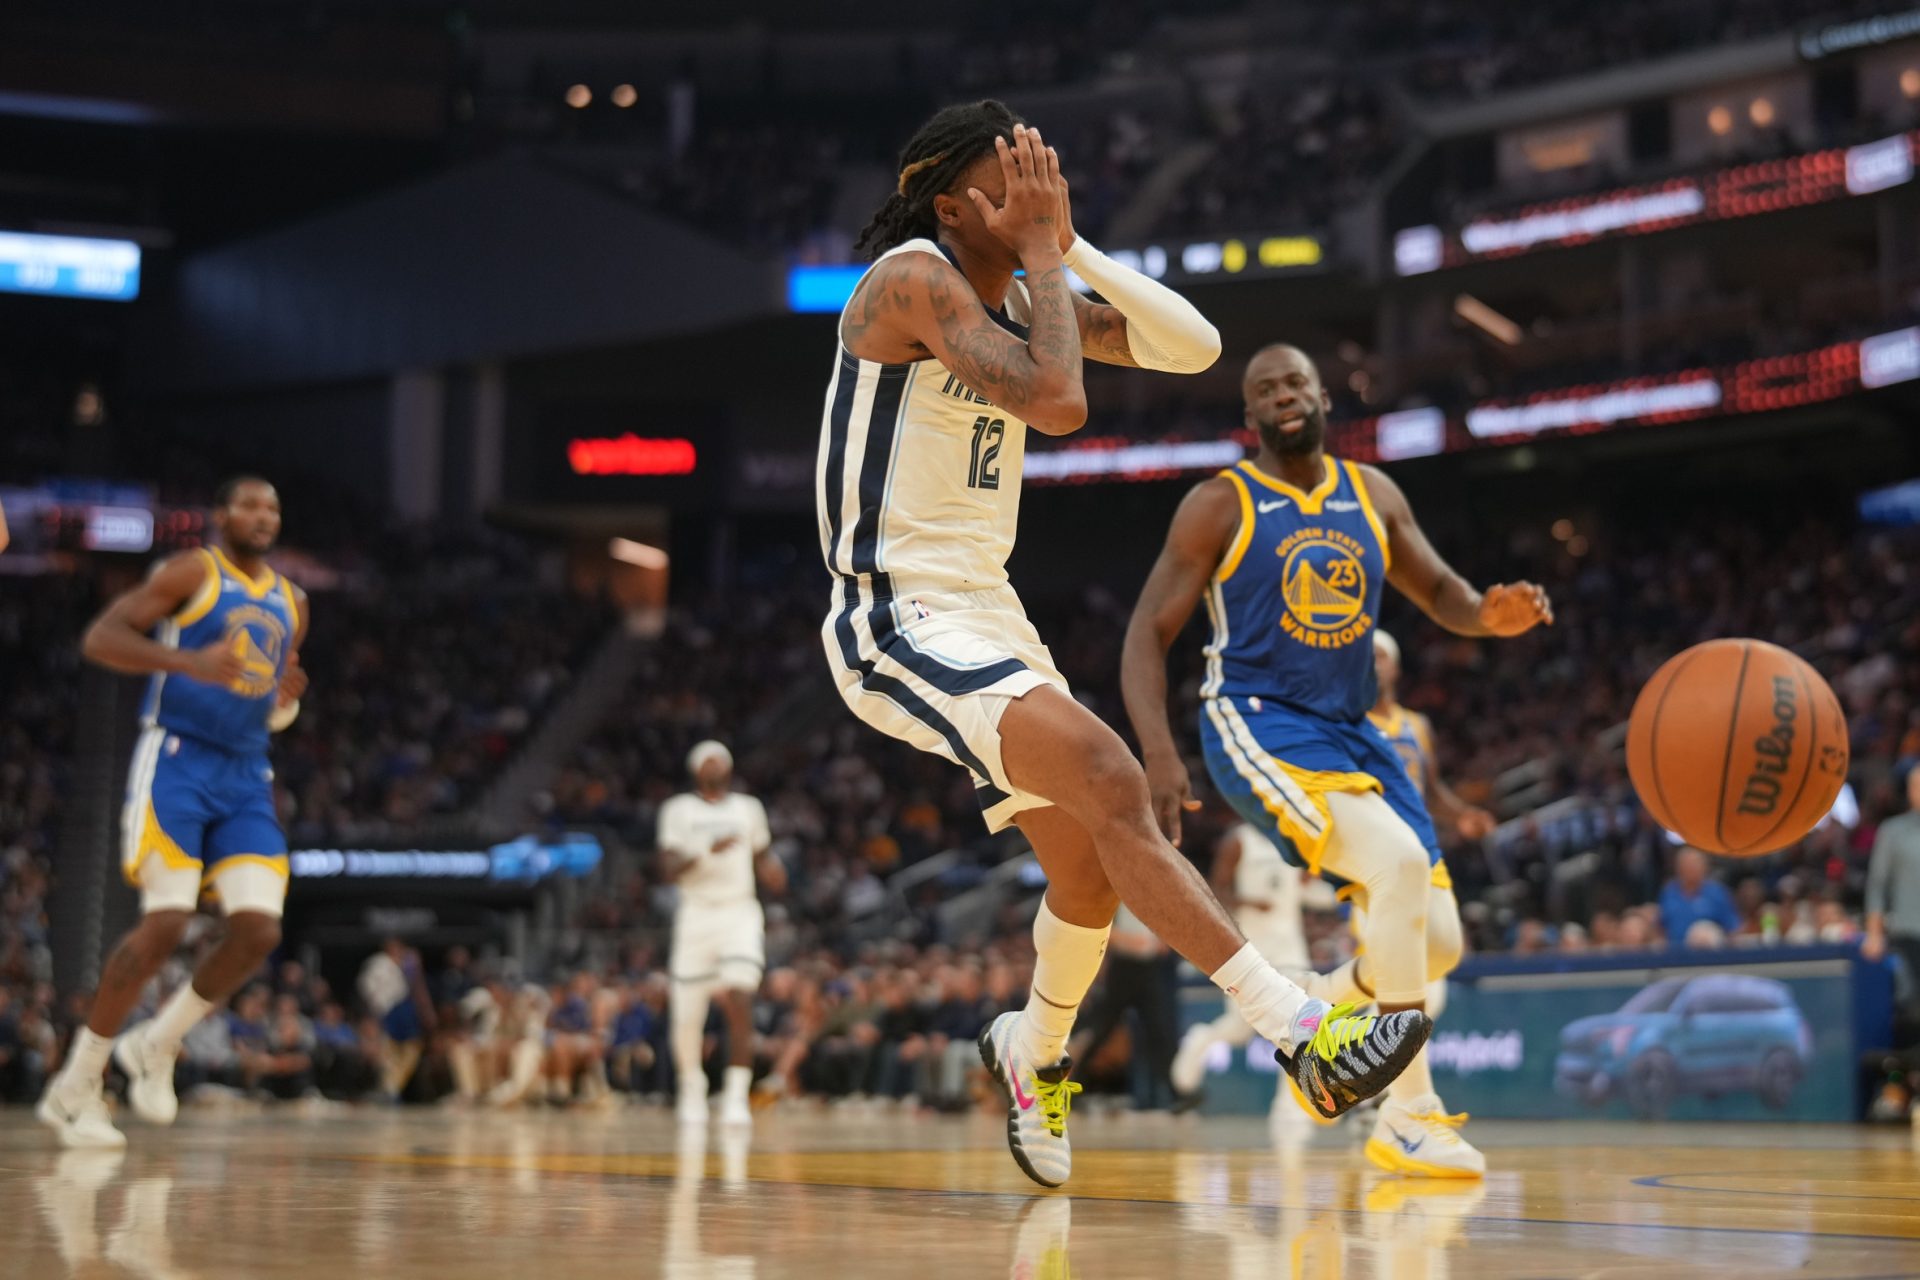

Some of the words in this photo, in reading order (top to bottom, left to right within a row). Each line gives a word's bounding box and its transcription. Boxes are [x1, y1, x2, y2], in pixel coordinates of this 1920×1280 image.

[968, 415, 1005, 490] 12
[1275, 527, 1323, 557] GOLDEN
[1326, 529, 1365, 557] STATE
[1326, 559, 1357, 587] 23
[1279, 611, 1373, 648] WARRIORS
[1737, 675, 1797, 816] Wilson
